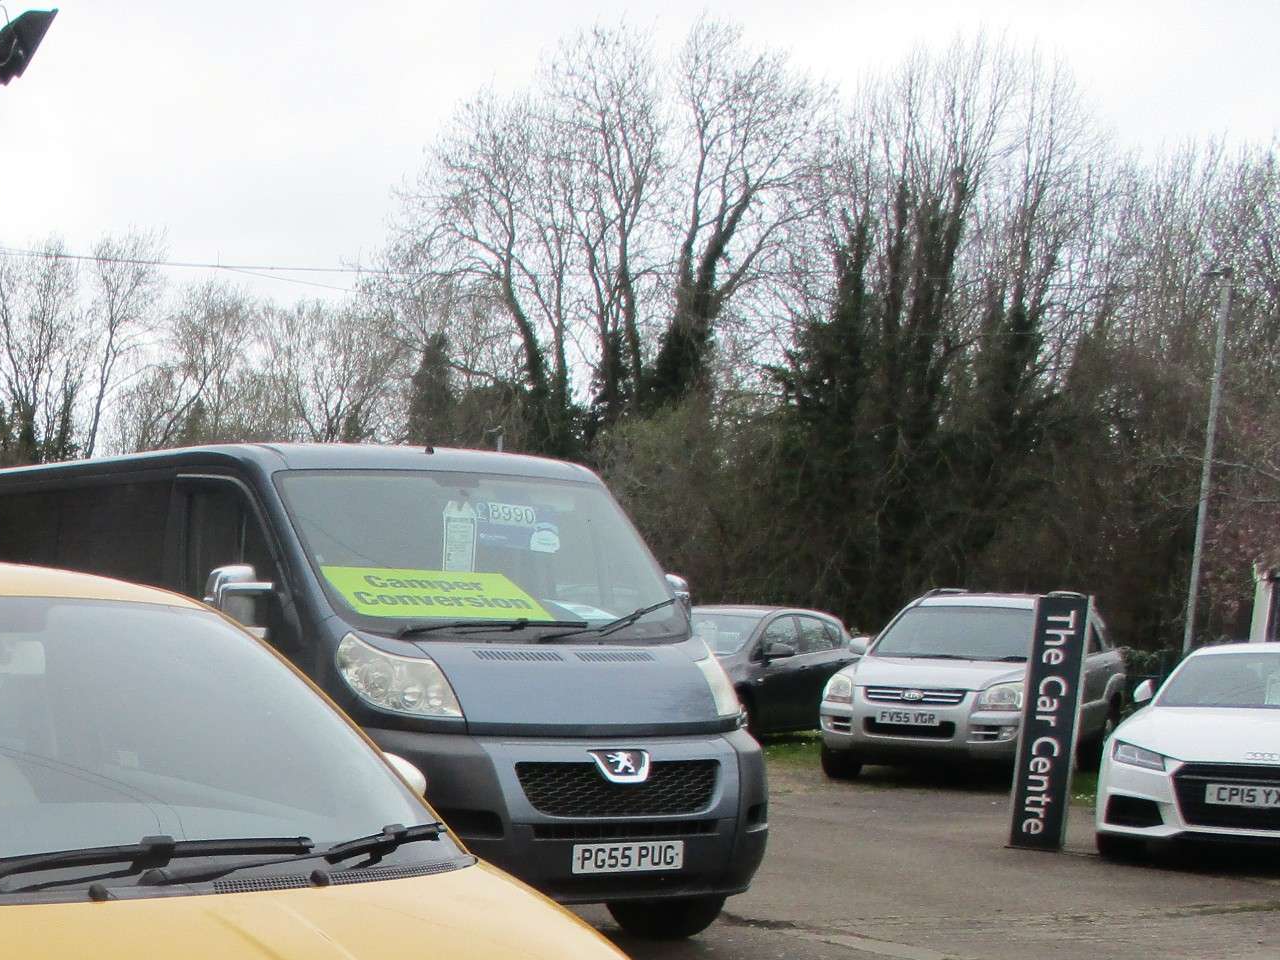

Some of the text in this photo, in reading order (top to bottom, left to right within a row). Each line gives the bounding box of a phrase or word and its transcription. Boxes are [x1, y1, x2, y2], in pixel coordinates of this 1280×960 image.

[363, 574, 484, 593] Camper
[353, 590, 533, 610] Conversion
[1022, 609, 1077, 835] The Car Centre
[1216, 786, 1257, 804] CP15
[580, 844, 676, 870] PG55 PUG
